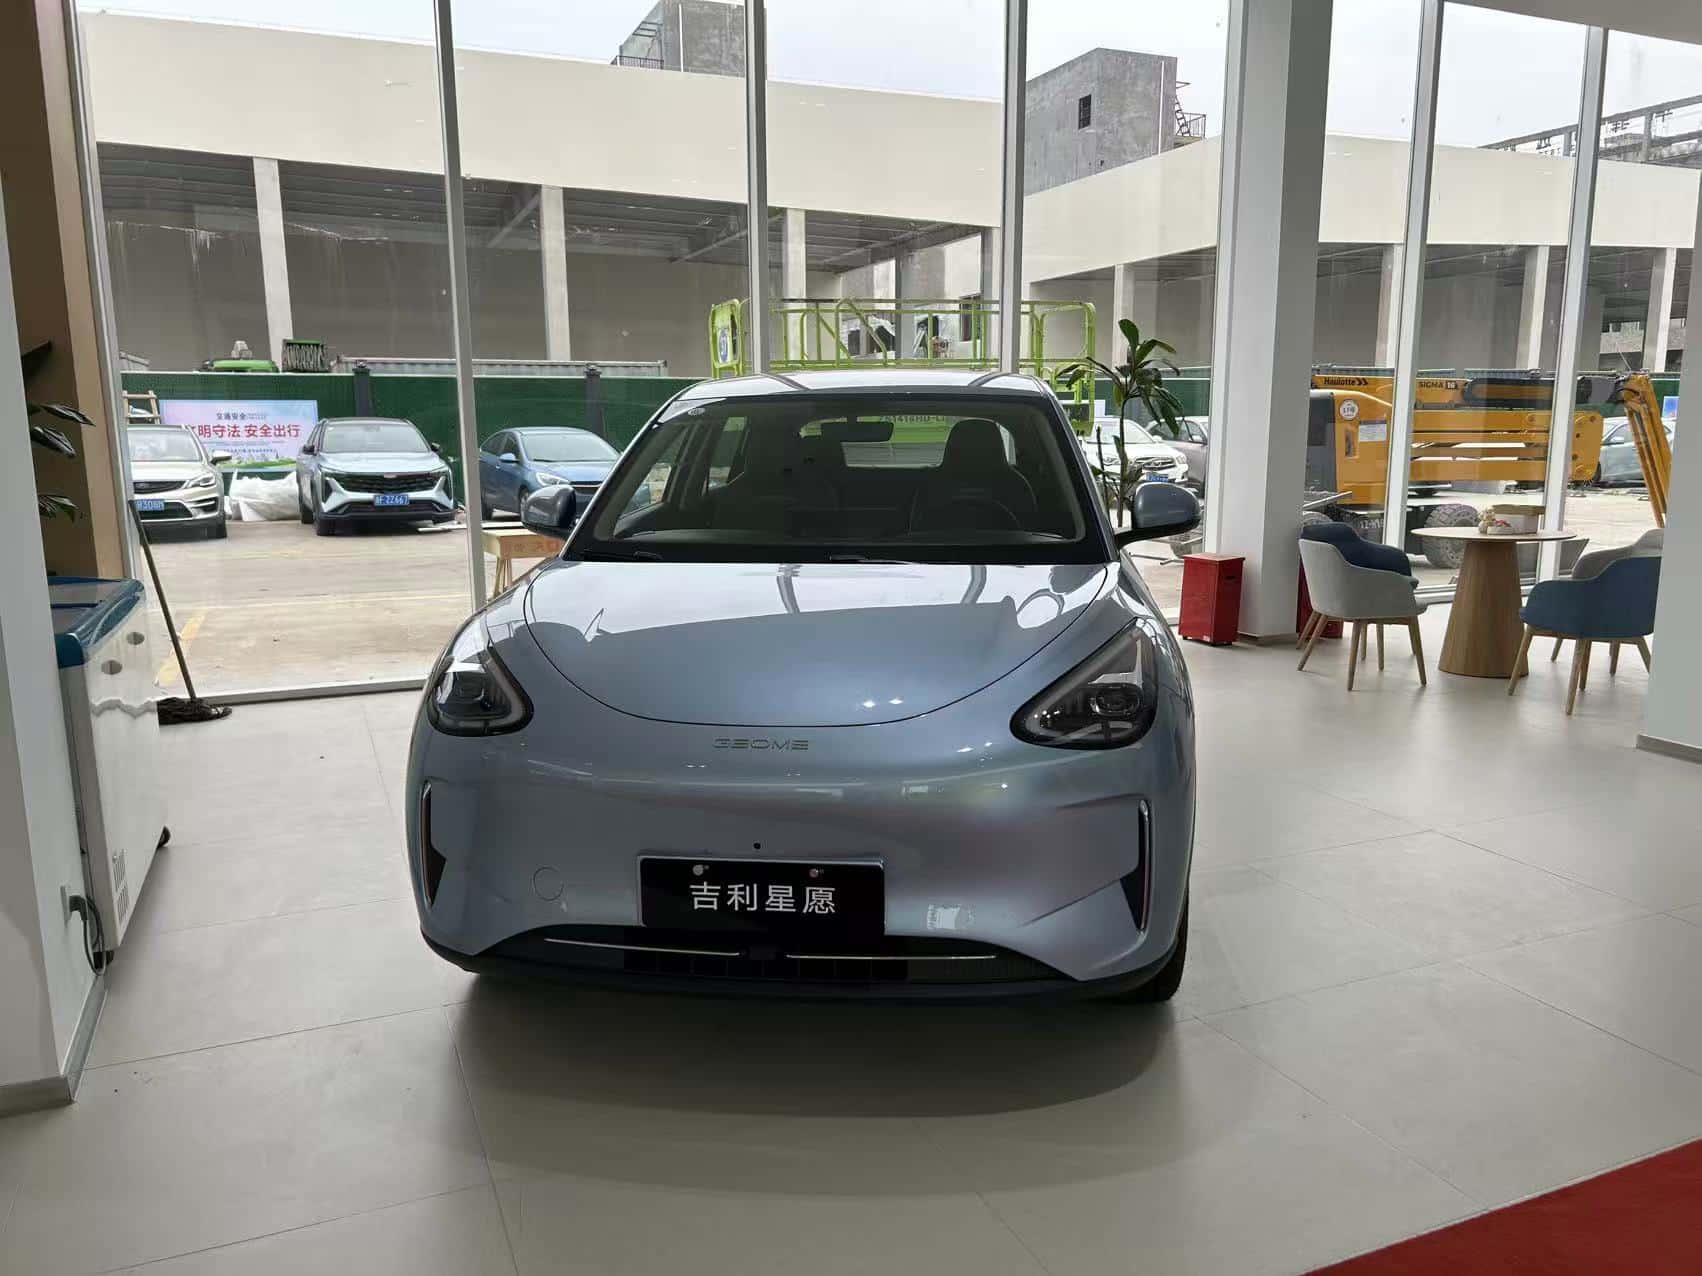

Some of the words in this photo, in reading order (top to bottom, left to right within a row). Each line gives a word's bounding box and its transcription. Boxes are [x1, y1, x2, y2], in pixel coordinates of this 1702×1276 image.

[1418, 381, 1443, 389] SIGMA
[244, 424, 300, 438] 安全出行
[712, 738, 809, 750] GEOME
[689, 881, 836, 914] 吉利星愿
